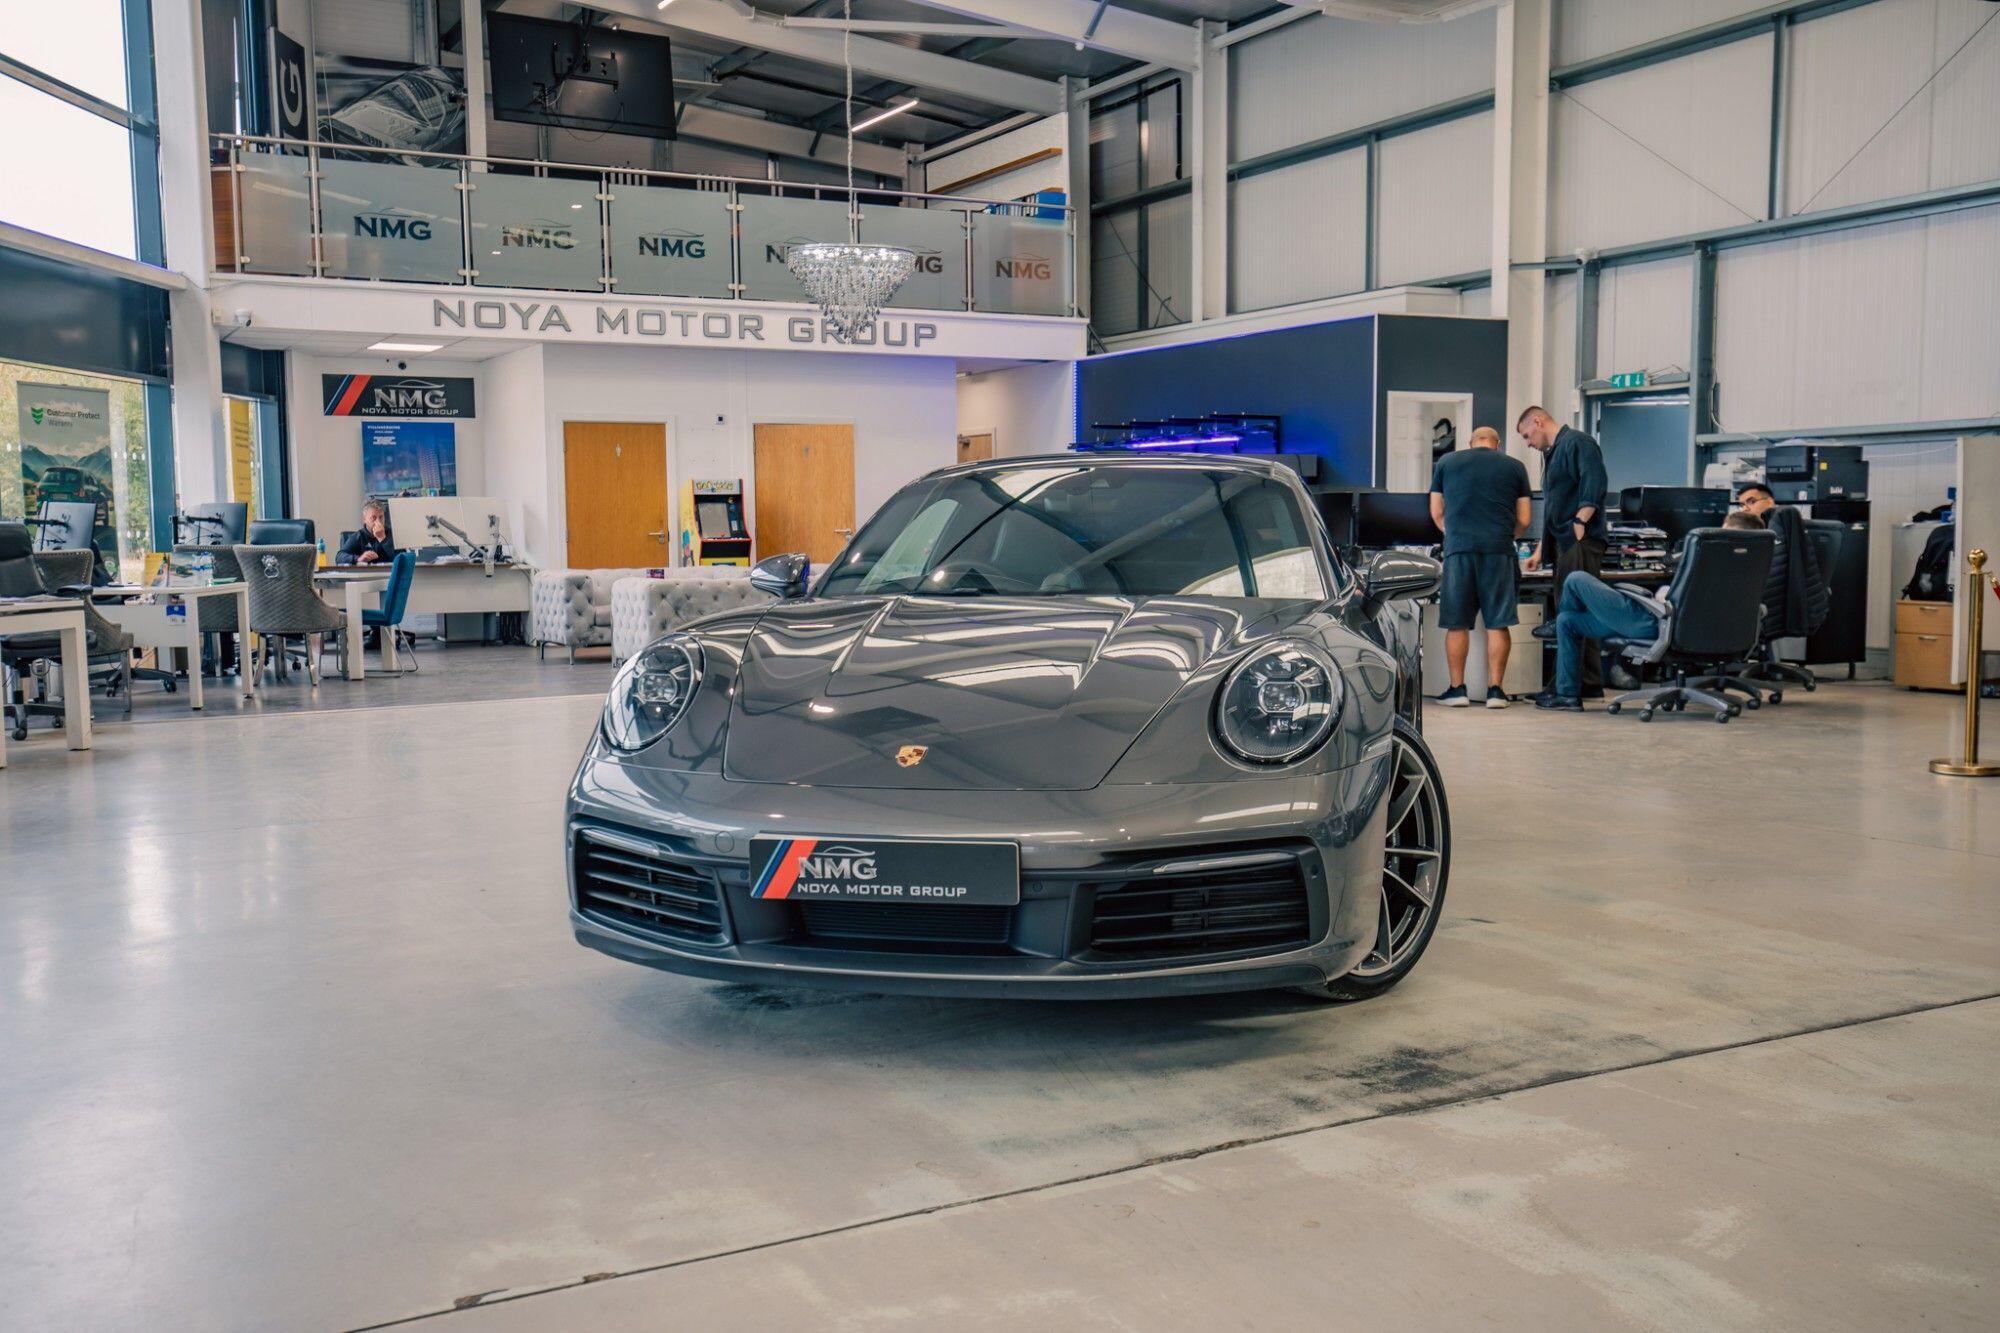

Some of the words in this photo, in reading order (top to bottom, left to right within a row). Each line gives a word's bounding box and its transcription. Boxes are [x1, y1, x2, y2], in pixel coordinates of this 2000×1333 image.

[354, 216, 432, 241] NMG
[639, 237, 706, 258] NMG
[996, 260, 1051, 280] NMG
[433, 300, 572, 333] NOYA
[596, 306, 765, 340] MOTOR
[788, 317, 937, 348] GROUP
[374, 388, 446, 408] NMG
[361, 407, 388, 415] NOYA
[427, 408, 460, 416] GROUP
[798, 856, 877, 881] NMG
[797, 883, 841, 895] NOYA
[846, 884, 903, 897] MOTOR
[909, 886, 967, 898] GROUP
